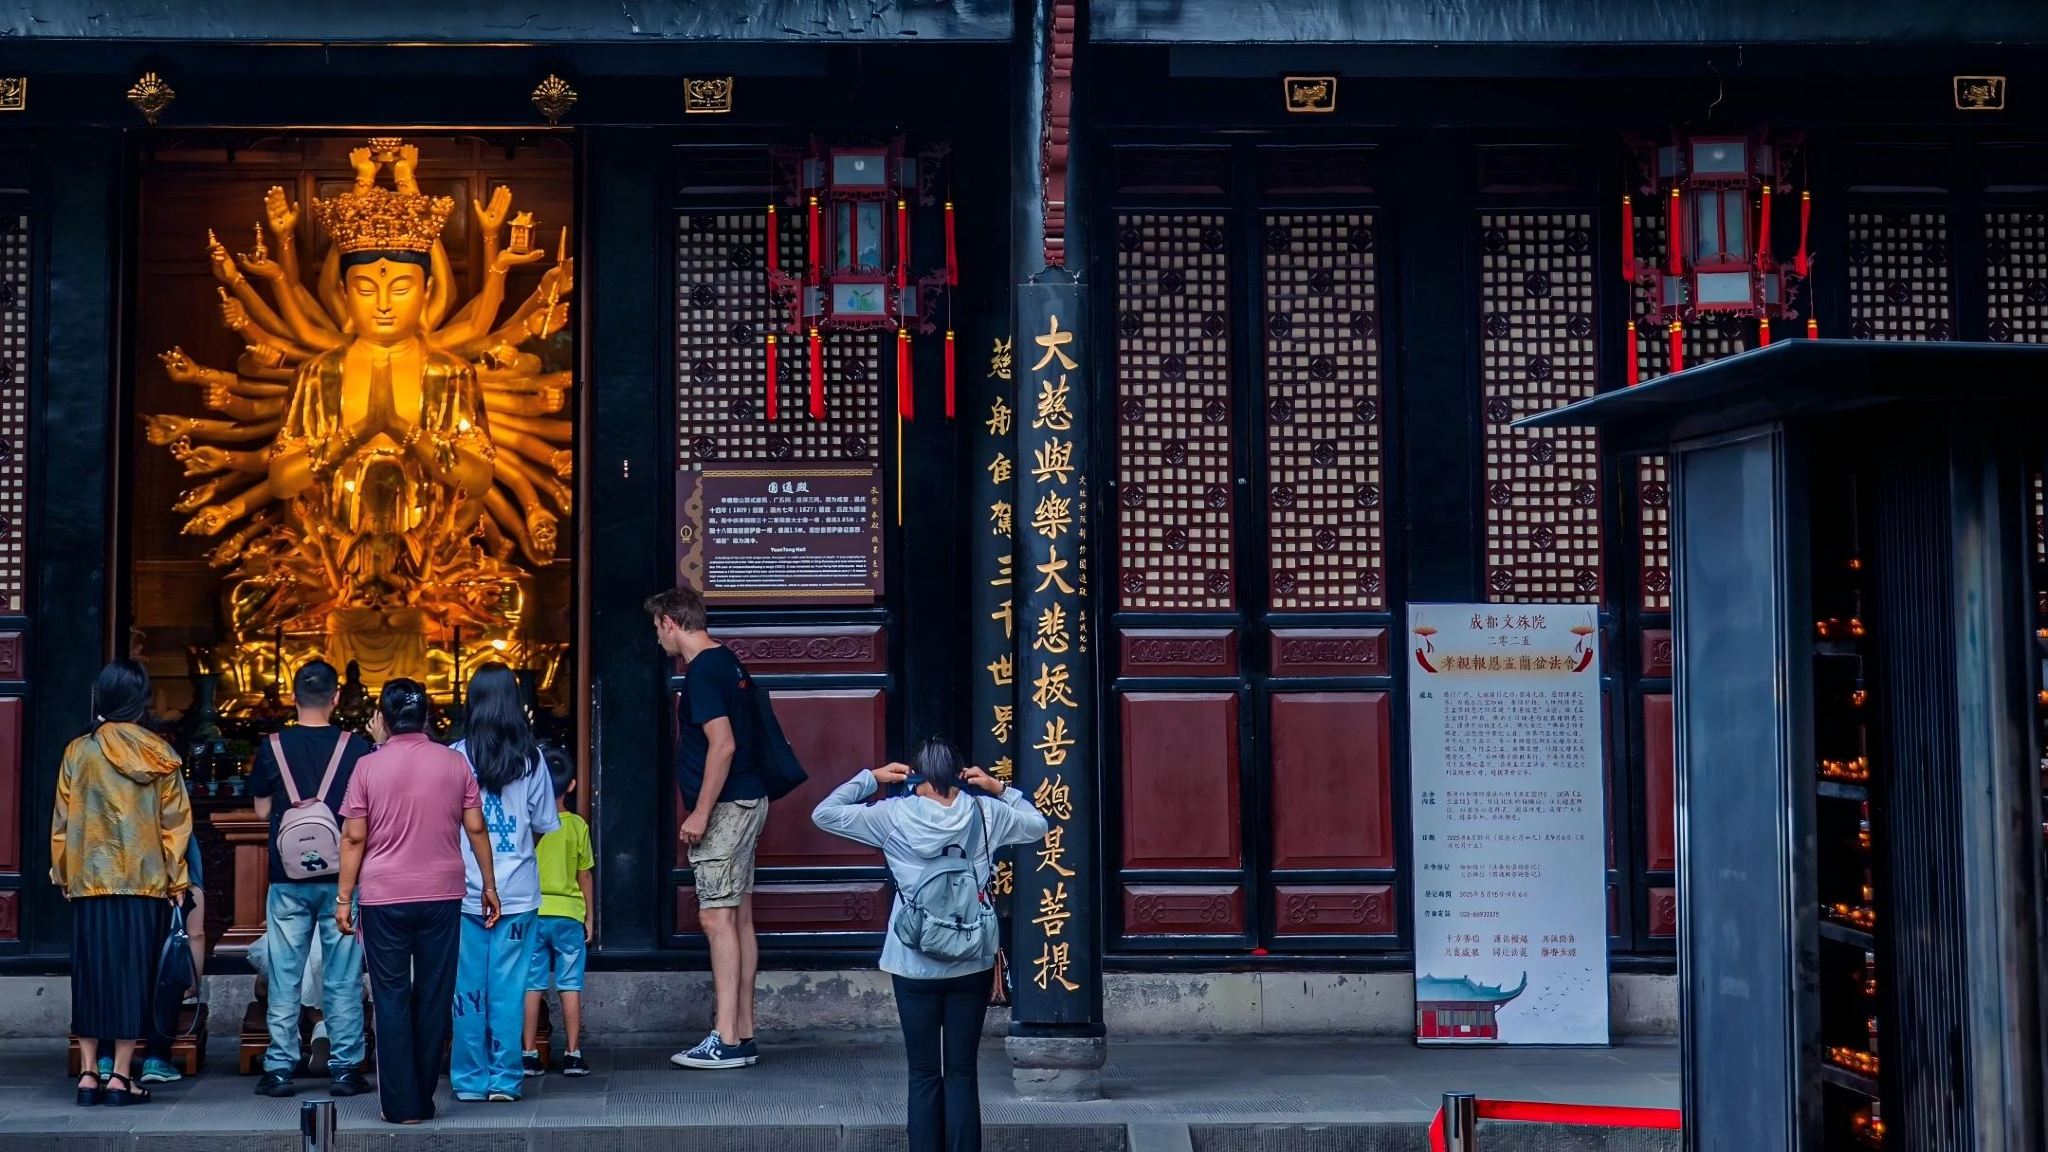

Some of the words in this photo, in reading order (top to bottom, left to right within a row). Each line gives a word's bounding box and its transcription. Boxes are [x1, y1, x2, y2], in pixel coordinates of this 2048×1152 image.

[1469, 613, 1546, 630] 成都文殊院
[1487, 635, 1531, 646] 二零二五
